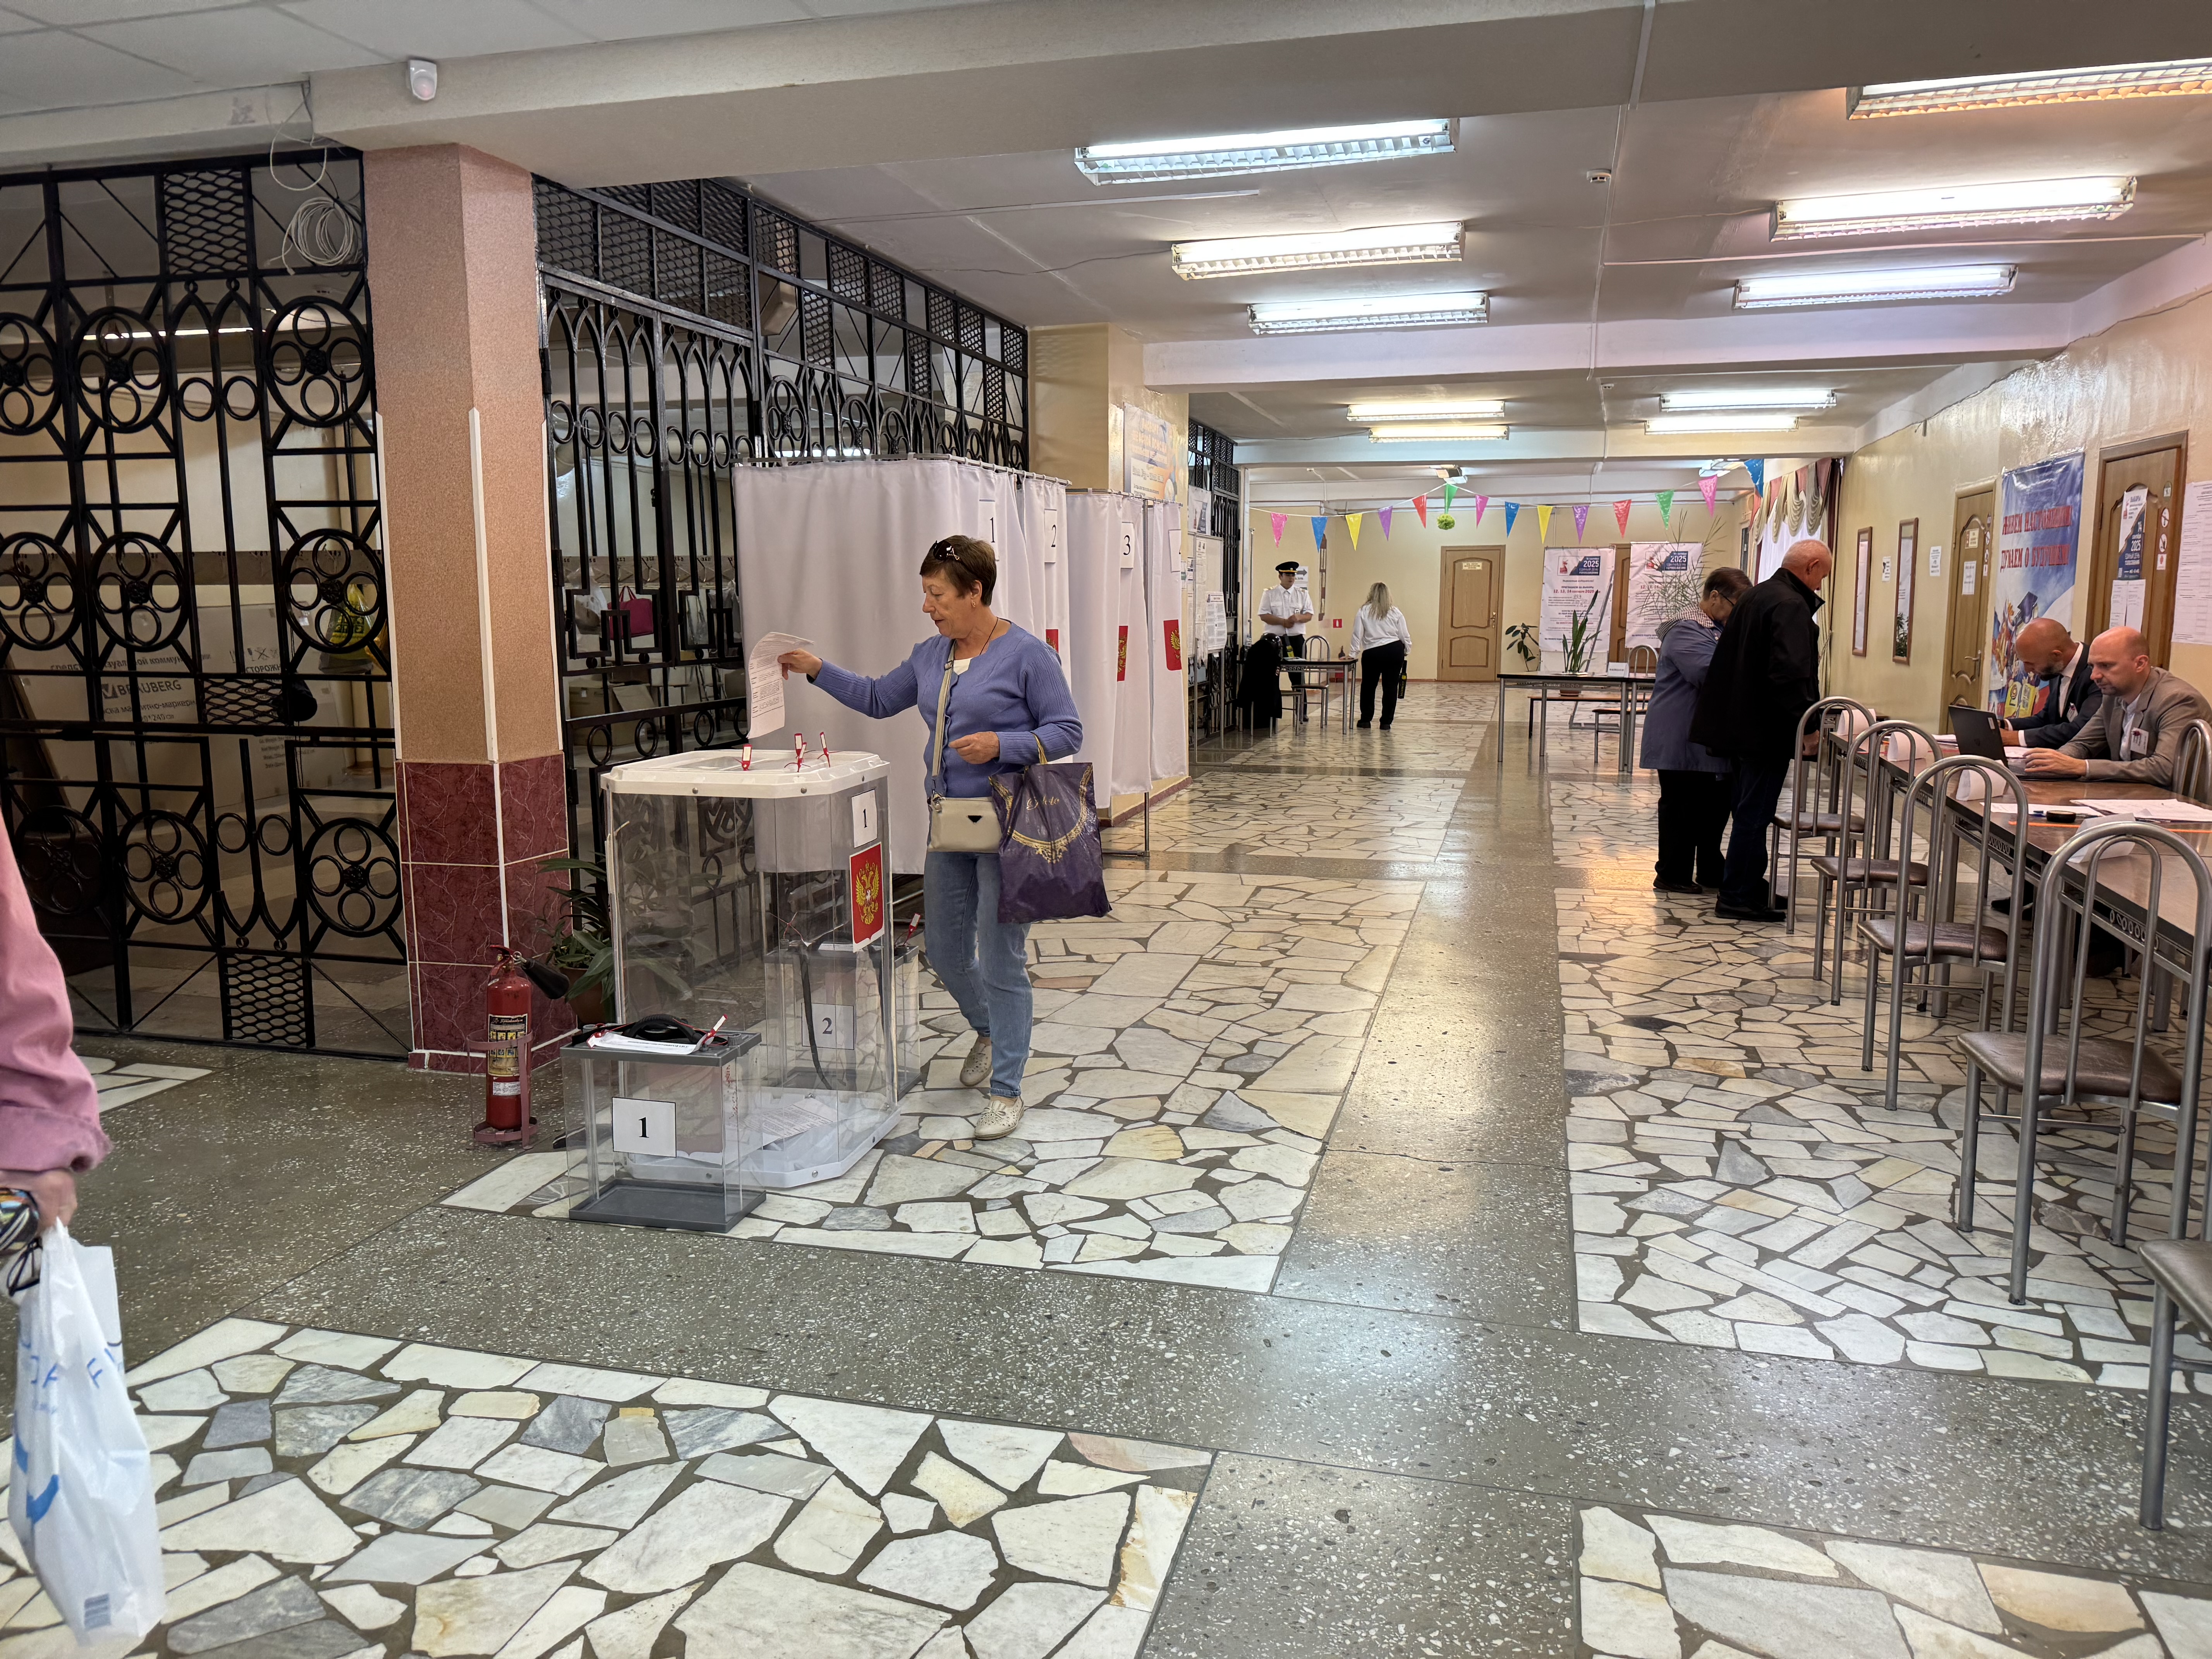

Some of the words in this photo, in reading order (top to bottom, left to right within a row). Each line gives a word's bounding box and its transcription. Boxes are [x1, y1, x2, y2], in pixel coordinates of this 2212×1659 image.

[990, 517, 995, 543] 1
[1051, 524, 1056, 547] 2
[1123, 535, 1130, 555] 3
[2001, 548, 2023, 573] ДУМАЕМ
[2025, 547, 2029, 567] О
[863, 809, 867, 828] 1
[822, 1017, 833, 1035] 2
[638, 1116, 649, 1138] 1
